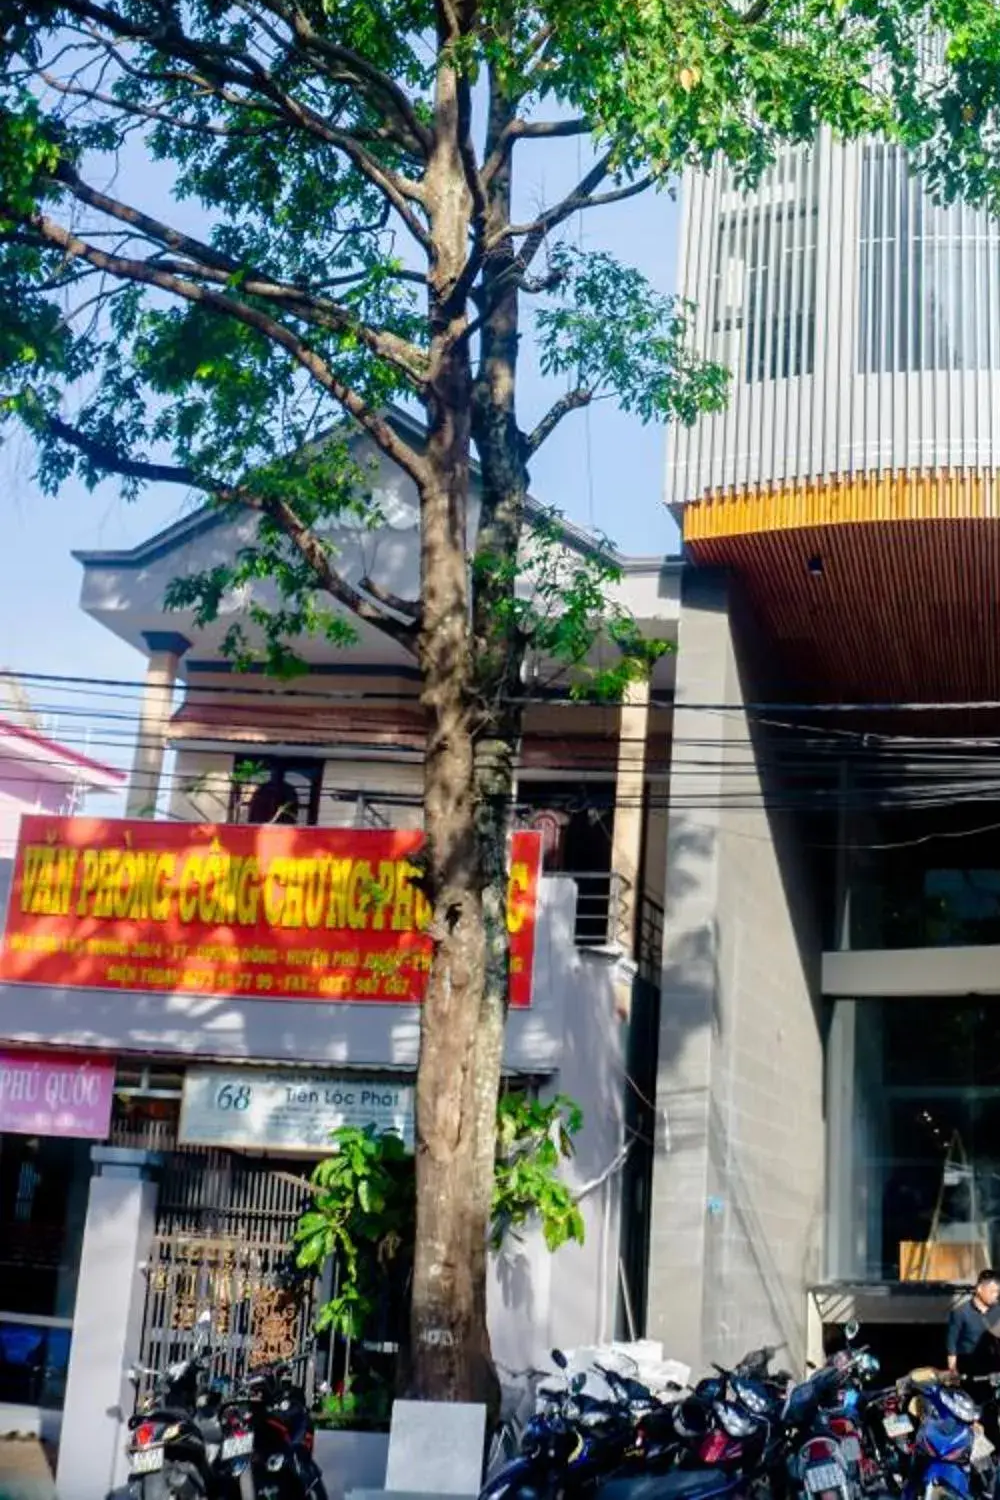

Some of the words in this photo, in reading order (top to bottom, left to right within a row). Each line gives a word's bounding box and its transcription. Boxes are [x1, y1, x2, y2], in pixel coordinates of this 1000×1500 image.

[20, 829, 76, 914] VĂN
[178, 836, 260, 926] CÔNG
[217, 1084, 251, 1111] 68
